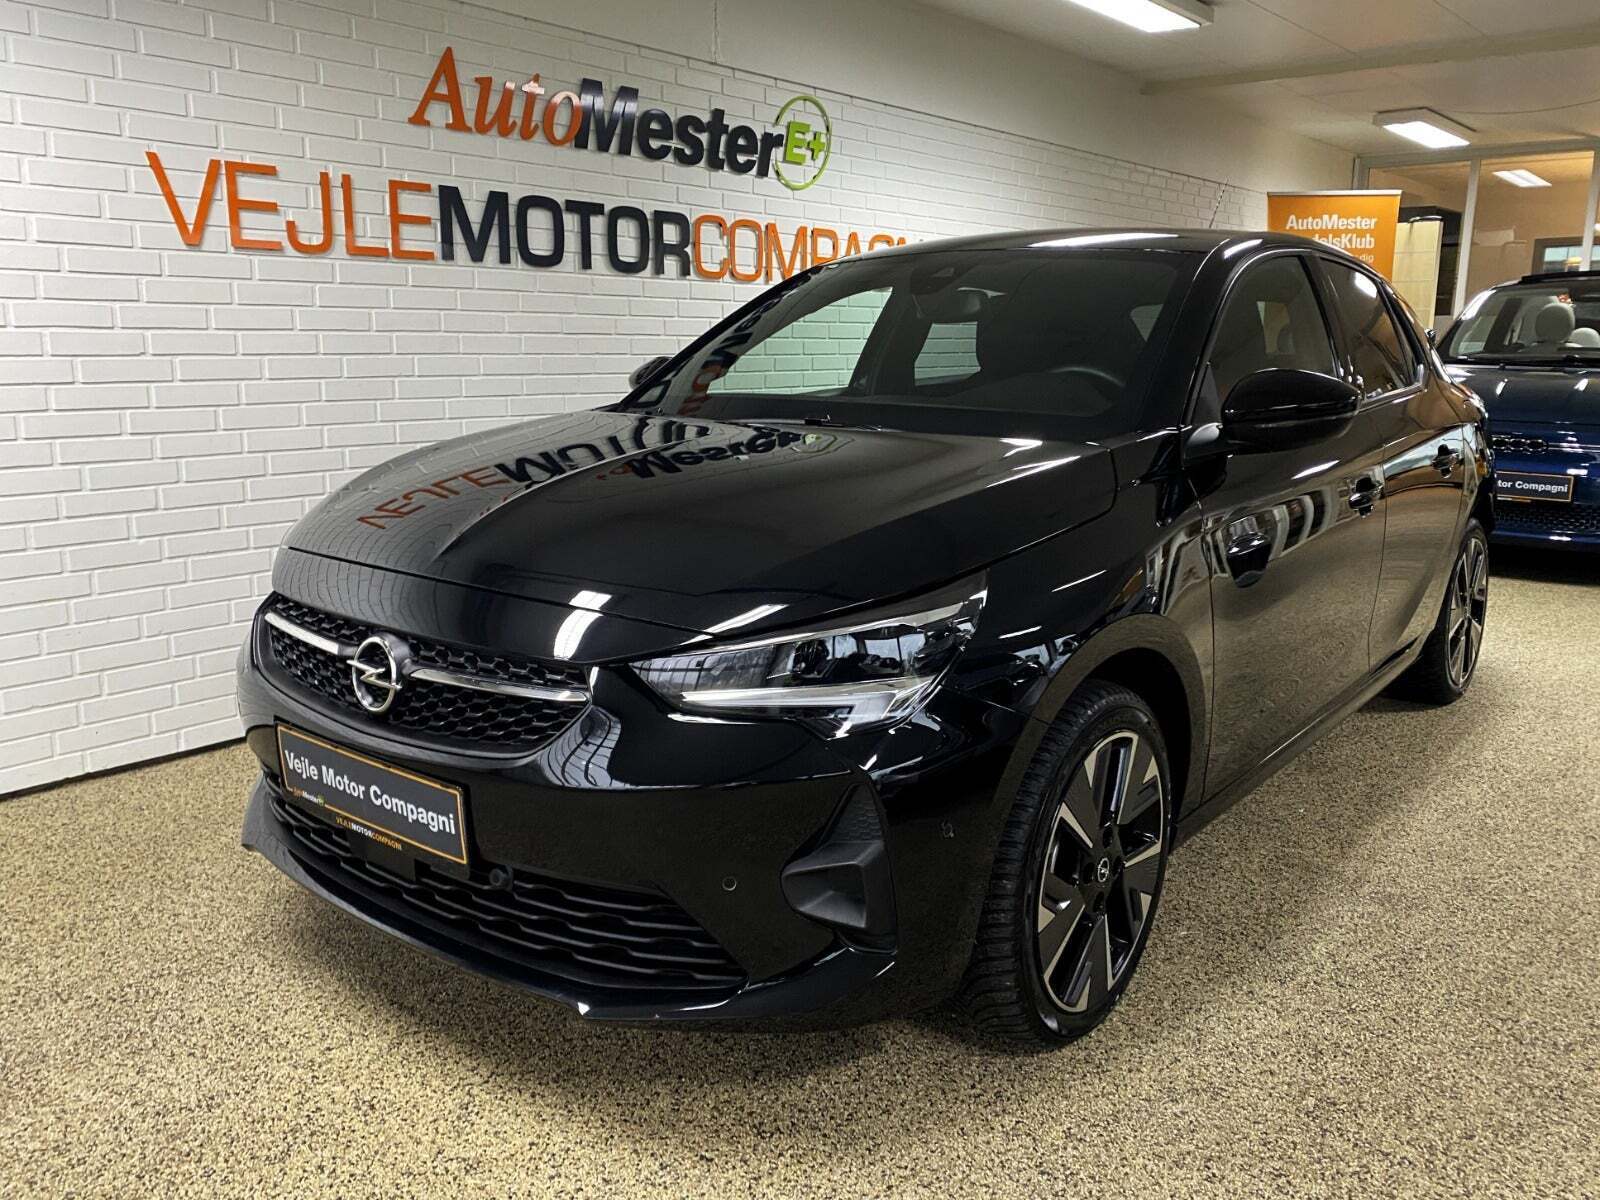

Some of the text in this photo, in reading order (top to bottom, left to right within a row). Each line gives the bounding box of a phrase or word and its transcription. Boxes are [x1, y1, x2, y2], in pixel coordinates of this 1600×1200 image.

[1285, 214, 1377, 230] AutoMester
[1515, 481, 1569, 493] Compagni
[284, 750, 456, 835] Vejle Motor Compagni
